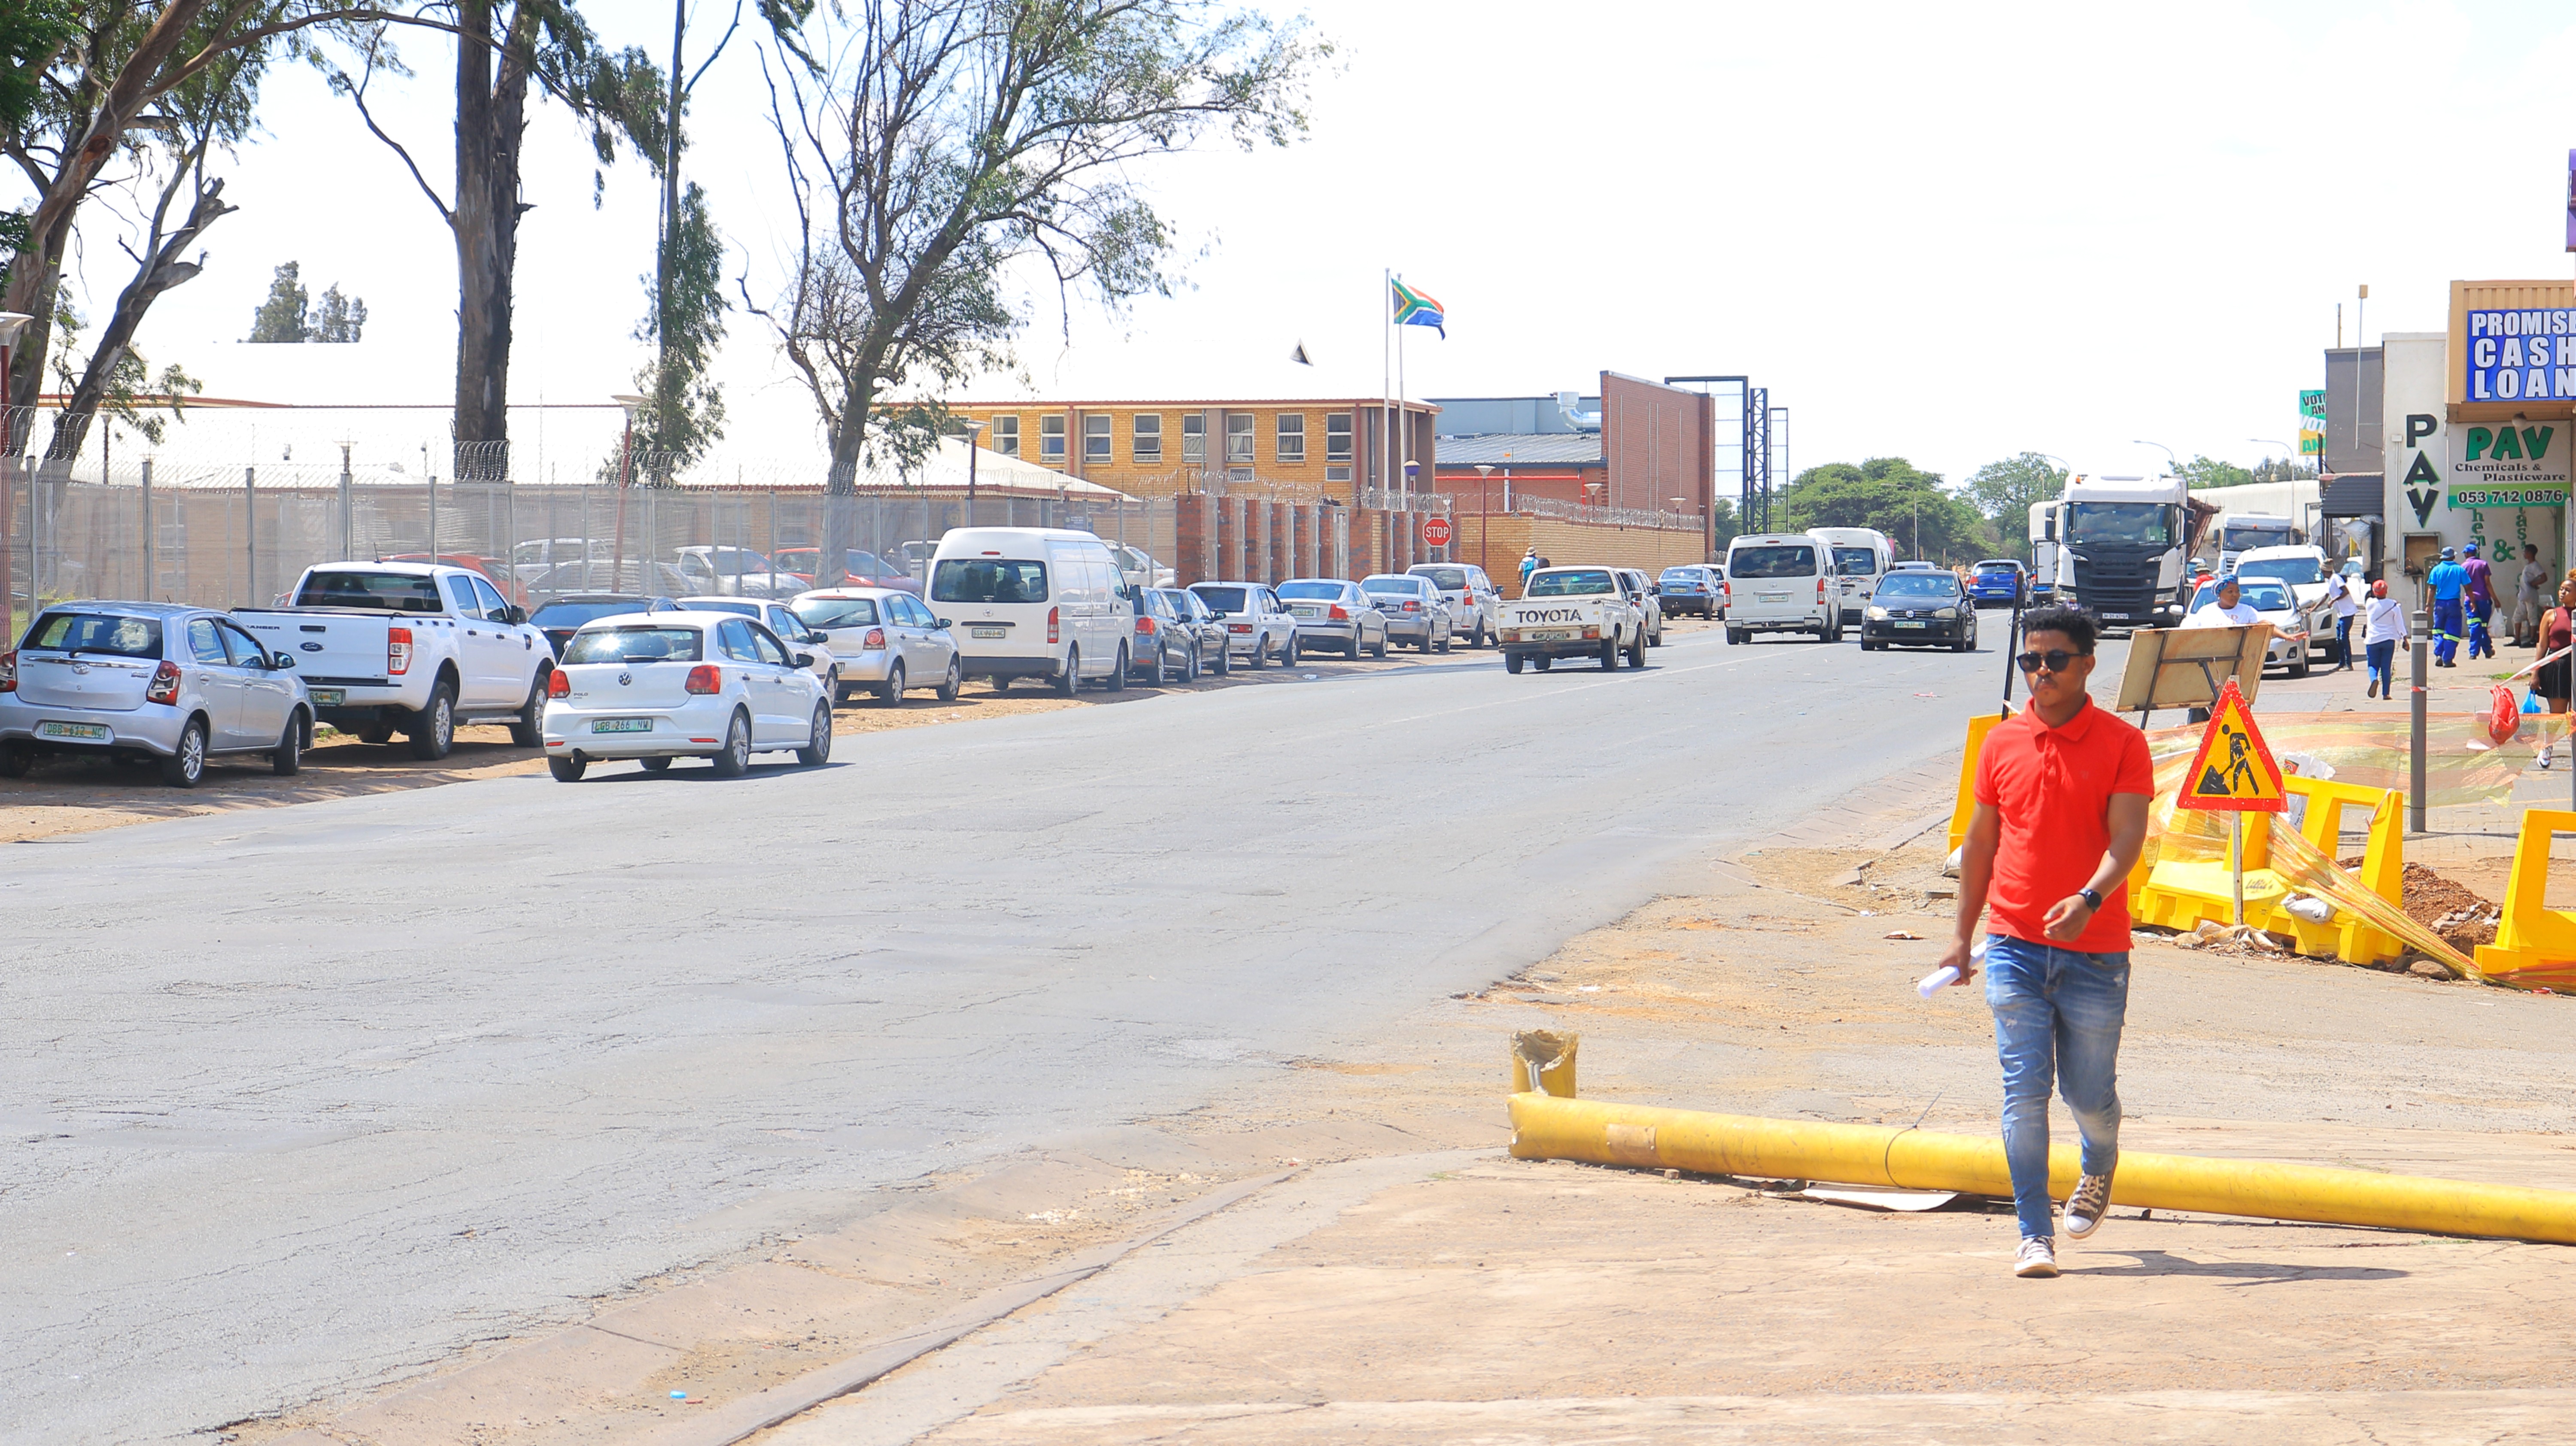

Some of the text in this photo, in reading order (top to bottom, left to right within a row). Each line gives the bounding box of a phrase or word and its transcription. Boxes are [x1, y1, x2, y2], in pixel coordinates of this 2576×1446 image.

[2474, 336, 2576, 368] CASH
[2475, 368, 2576, 399] LOAN
[2466, 425, 2554, 462] PAV
[2403, 414, 2440, 529] PAV
[2455, 463, 2527, 471] Chemicals
[2483, 473, 2566, 481] Plasticware
[2458, 490, 2563, 503] 053 712 0876
[1426, 526, 1449, 538] STOP
[2493, 539, 2516, 562] &
[1515, 609, 1583, 623] TOYOTA
[330, 693, 339, 702] NC
[47, 723, 103, 737] DBB 612 NC
[595, 720, 648, 730] LGB 266 NW
